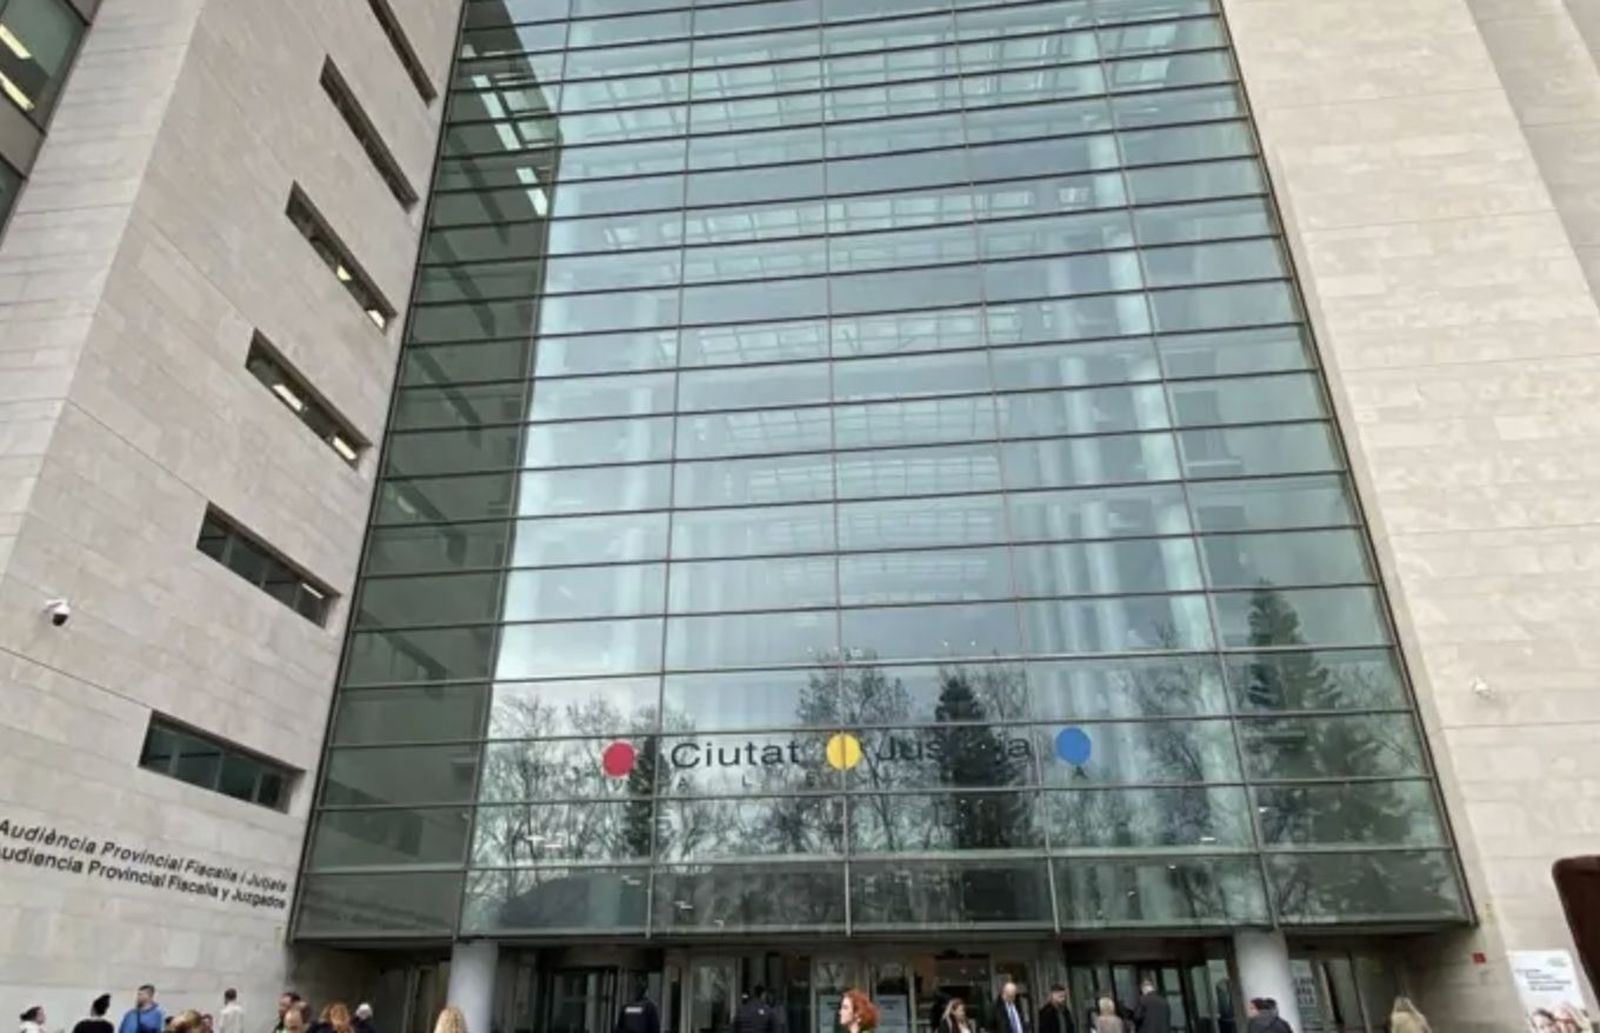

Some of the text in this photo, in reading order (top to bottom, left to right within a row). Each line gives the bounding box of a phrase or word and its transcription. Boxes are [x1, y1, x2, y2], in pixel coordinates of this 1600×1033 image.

[670, 739, 801, 769] Ciutat
[101, 841, 184, 873] Provincial
[0, 846, 83, 874] udiencia
[88, 860, 166, 888] Provincial
[221, 888, 230, 902] y
